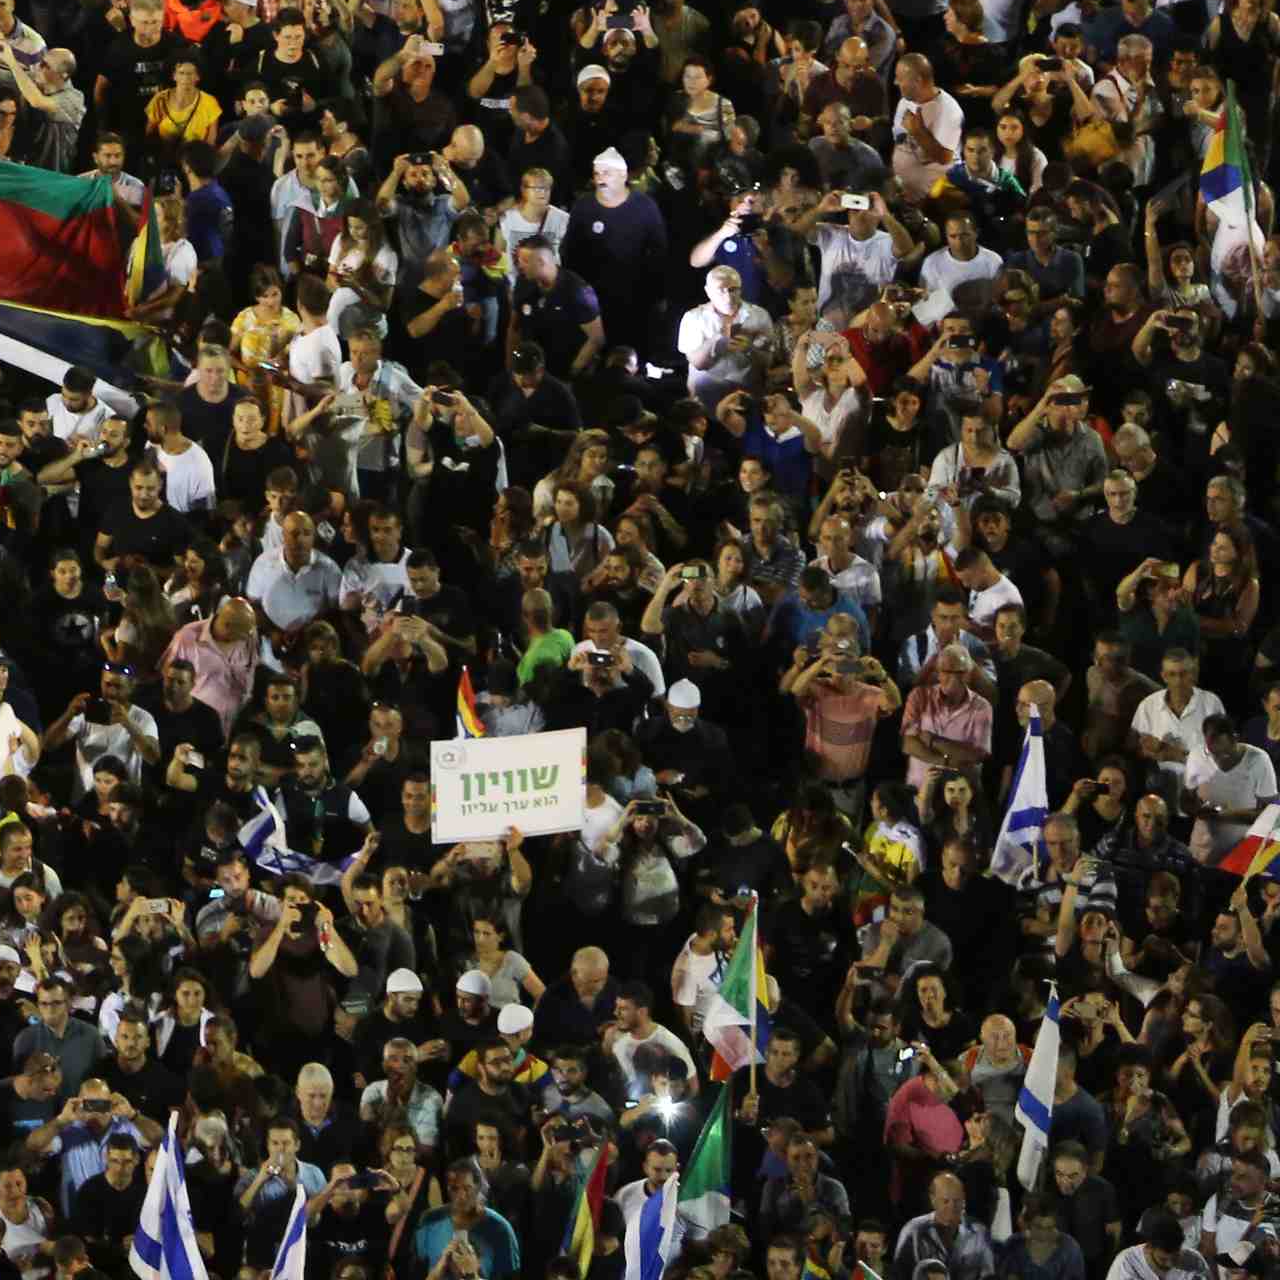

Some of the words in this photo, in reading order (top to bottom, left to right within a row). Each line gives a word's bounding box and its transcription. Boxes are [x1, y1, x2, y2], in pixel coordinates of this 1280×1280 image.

[459, 764, 560, 802] שוויון
[503, 799, 529, 814] ערך
[533, 795, 559, 808] הוא
[461, 802, 499, 817] עליון
